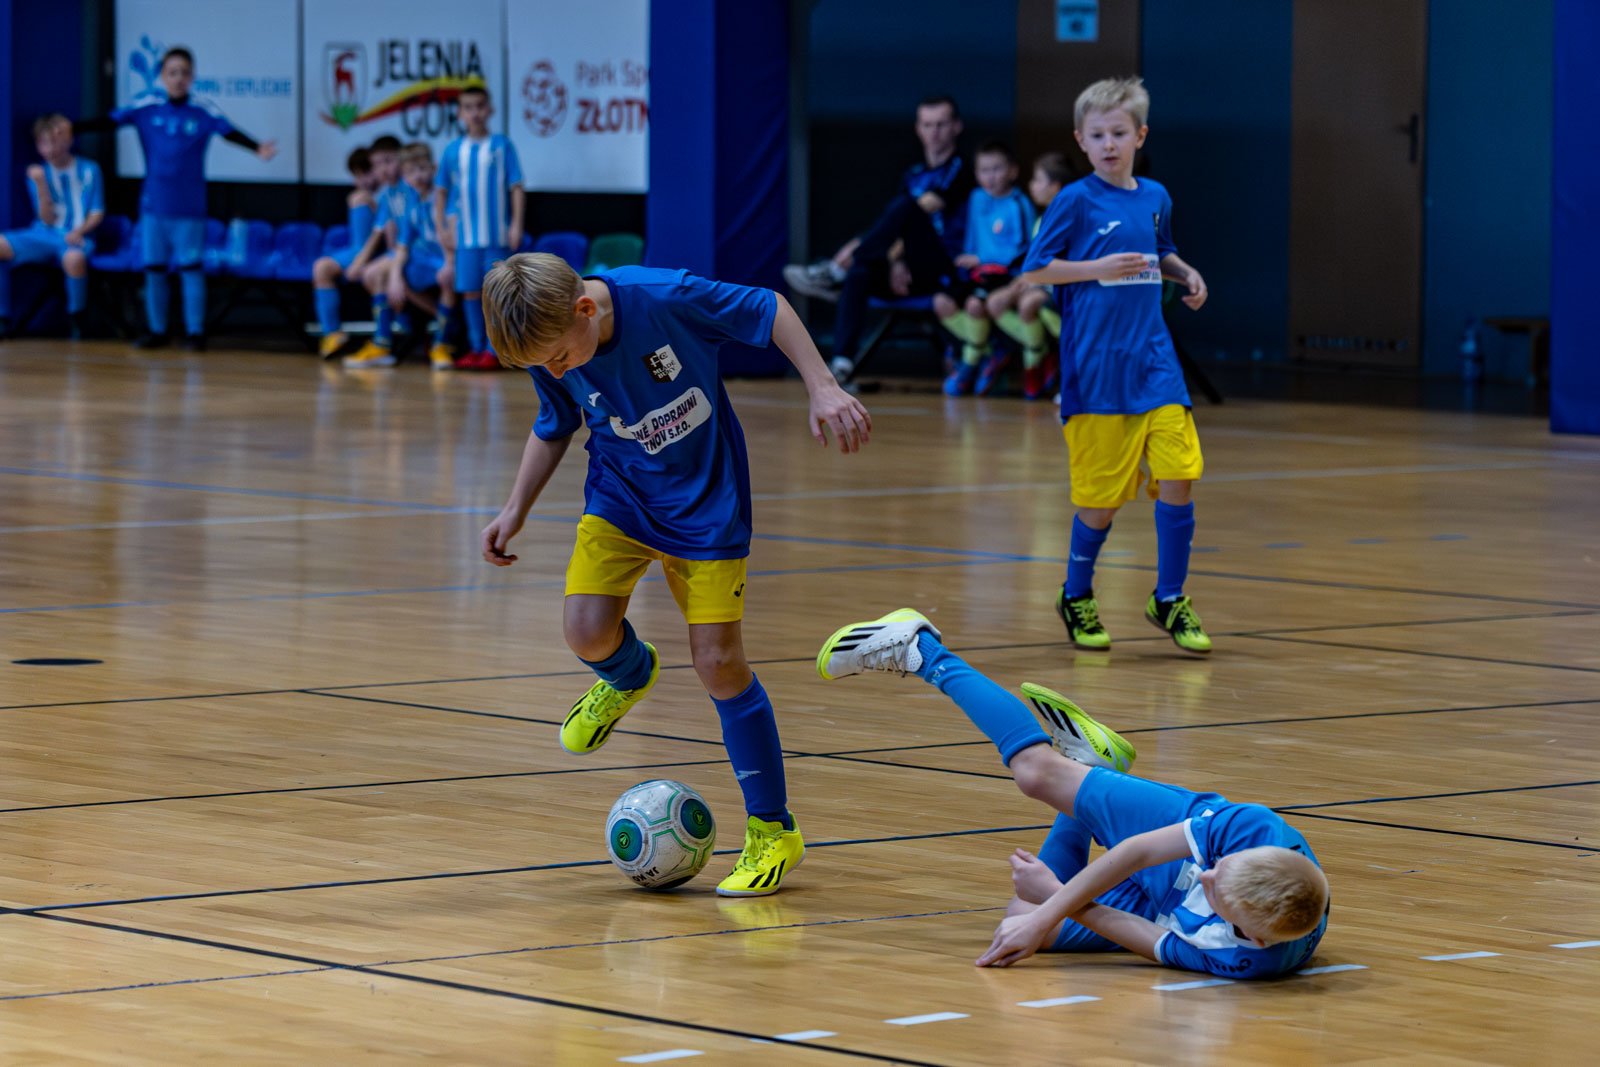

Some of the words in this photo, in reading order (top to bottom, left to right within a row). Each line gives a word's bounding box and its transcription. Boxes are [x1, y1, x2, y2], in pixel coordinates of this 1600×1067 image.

[375, 40, 485, 88] JELENIA
[622, 60, 649, 89] Sp
[651, 390, 698, 431] DOPRAVNÍ
[643, 429, 667, 452] TNOV
